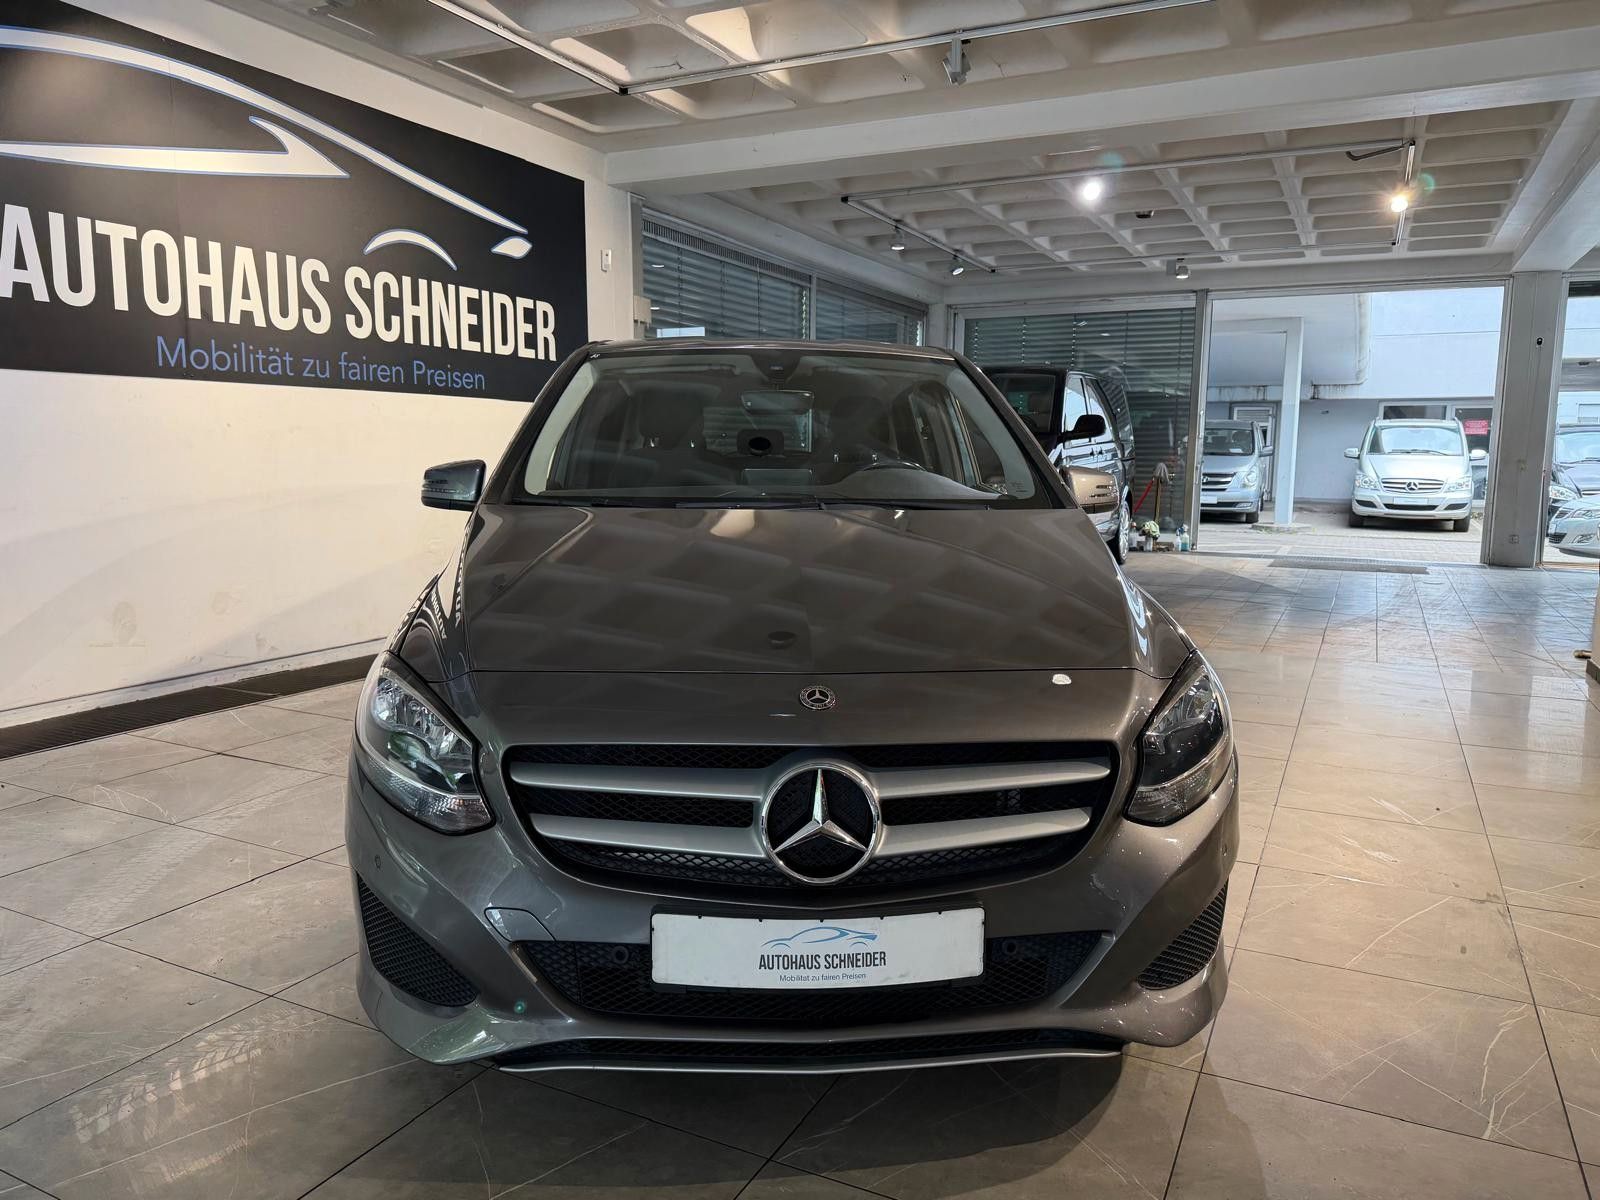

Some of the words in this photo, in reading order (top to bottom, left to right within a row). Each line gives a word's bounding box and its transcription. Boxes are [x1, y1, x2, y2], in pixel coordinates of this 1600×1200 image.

[0, 204, 331, 335] AUTOHAUS
[345, 265, 557, 362] SCHNEIDER
[156, 335, 294, 376] Mobilität
[302, 357, 330, 379] zu
[338, 351, 404, 384] fairen
[413, 360, 486, 391] Preisen
[758, 954, 821, 971] AUTOHAUS
[824, 951, 887, 970] SCHNEIDER
[821, 973, 840, 981] fairen
[841, 972, 867, 980] Preisen
